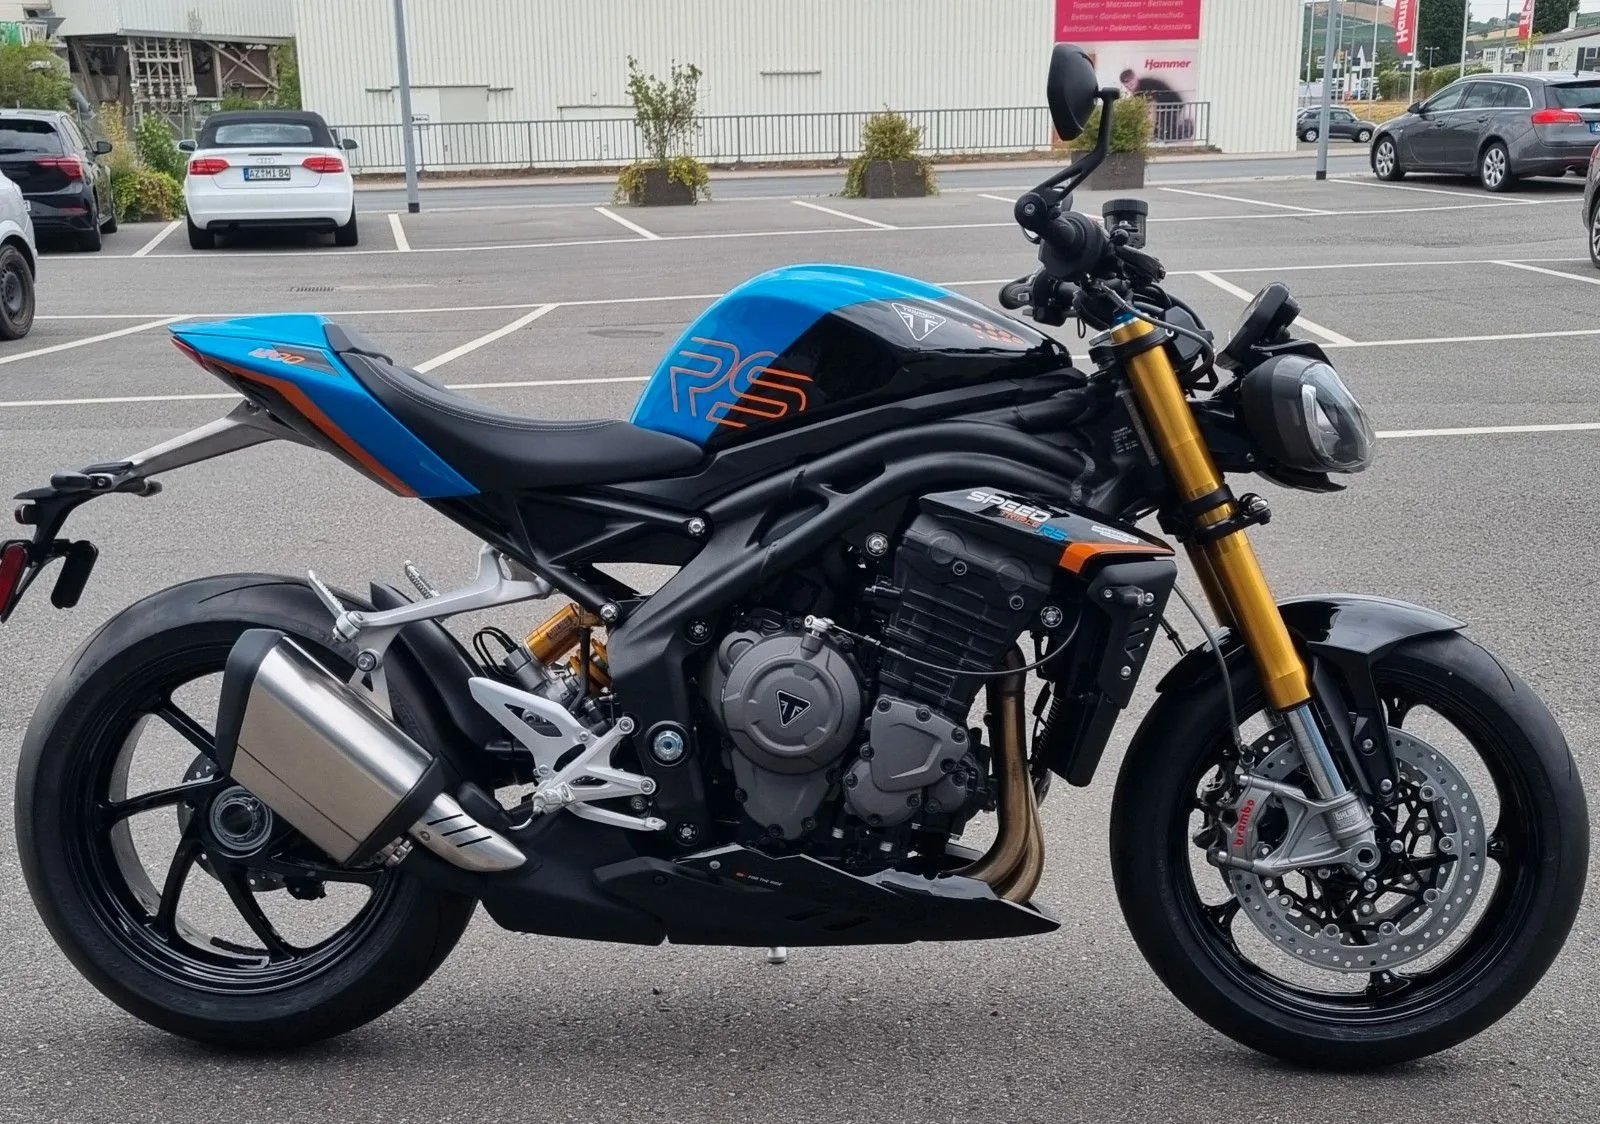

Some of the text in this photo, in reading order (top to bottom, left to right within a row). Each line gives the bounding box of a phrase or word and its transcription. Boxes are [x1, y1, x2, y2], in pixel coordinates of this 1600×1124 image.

[1099, 12, 1131, 20] Gardinen
[1109, 24, 1147, 32] Dekoration
[1144, 58, 1192, 70] Hammer
[278, 169, 289, 178] 84
[670, 336, 814, 428] RS
[966, 490, 1052, 522] SPEED
[1034, 524, 1068, 541] RS
[1232, 799, 1255, 846] brembo
